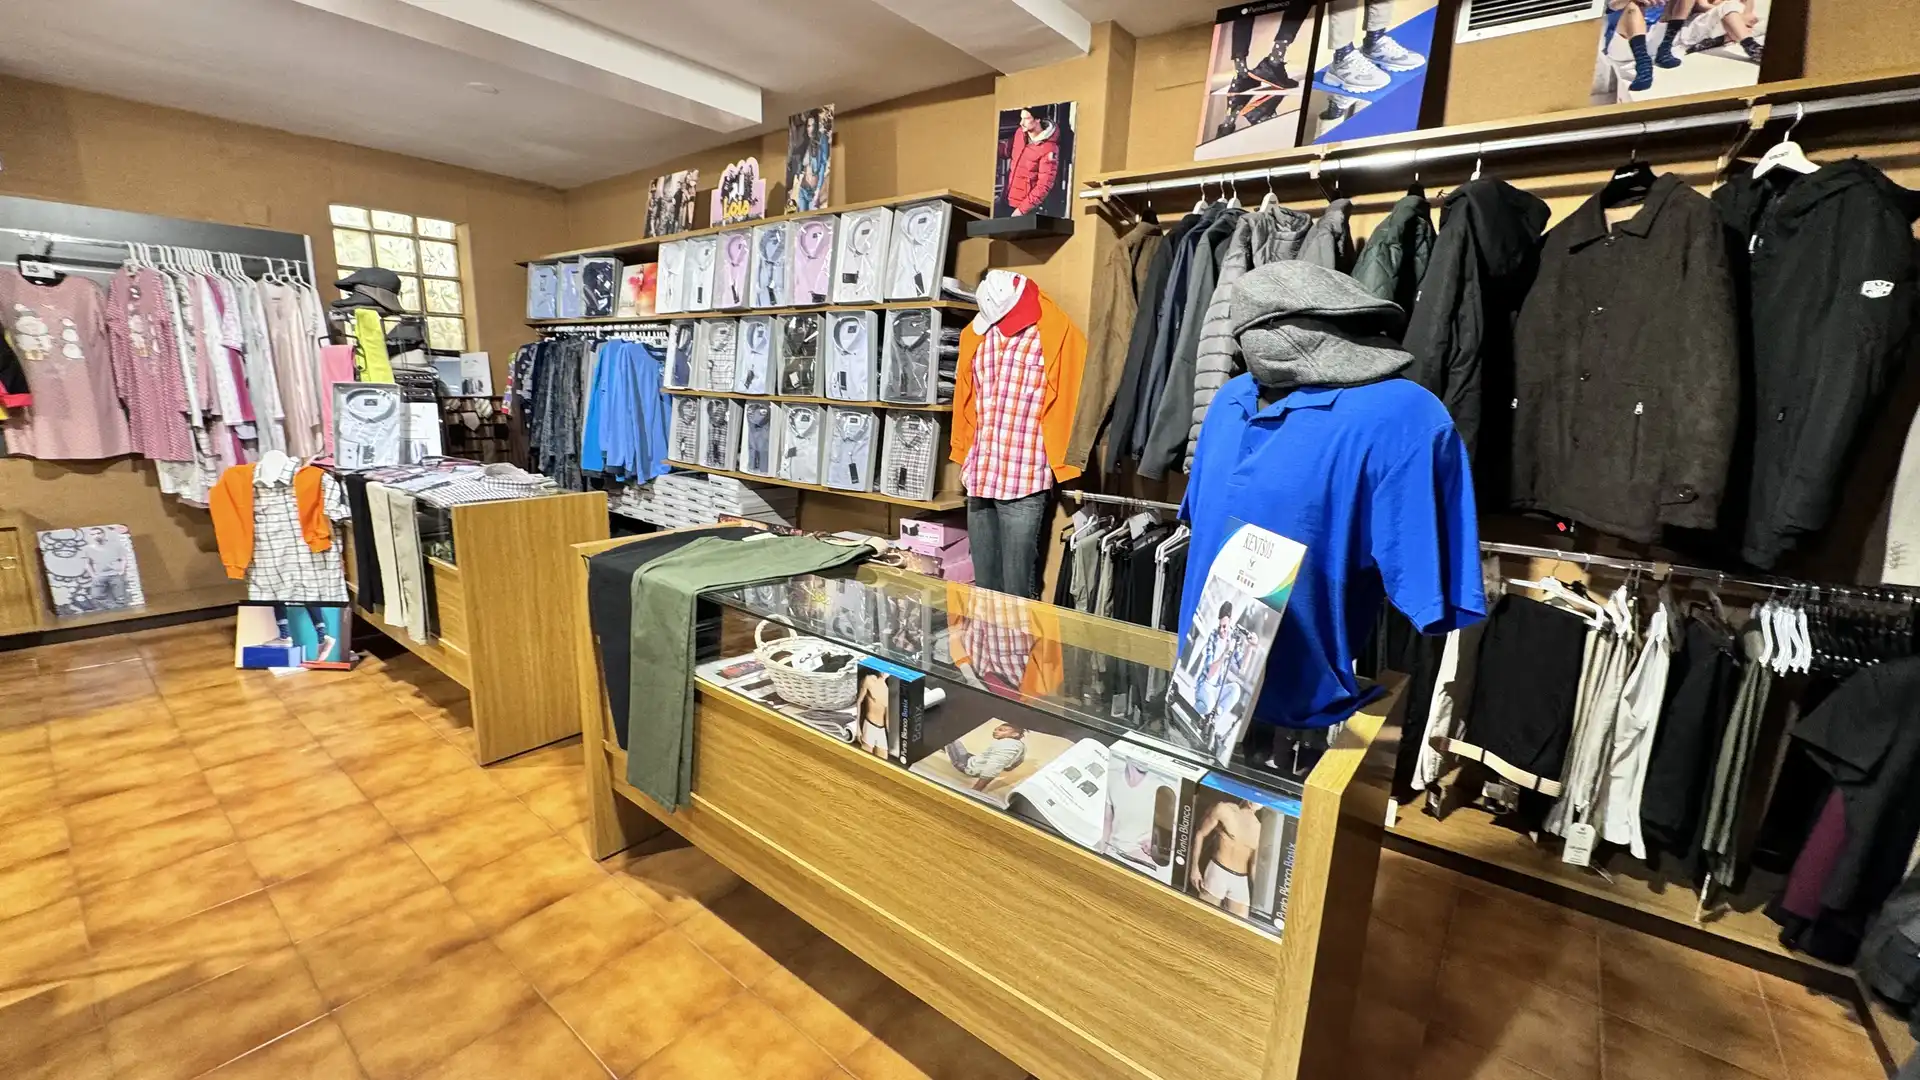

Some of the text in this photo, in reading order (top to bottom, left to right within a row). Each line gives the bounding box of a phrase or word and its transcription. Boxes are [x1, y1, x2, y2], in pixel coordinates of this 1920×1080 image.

[912, 706, 922, 742] Basix
[1176, 804, 1192, 857] Punto Blanco
